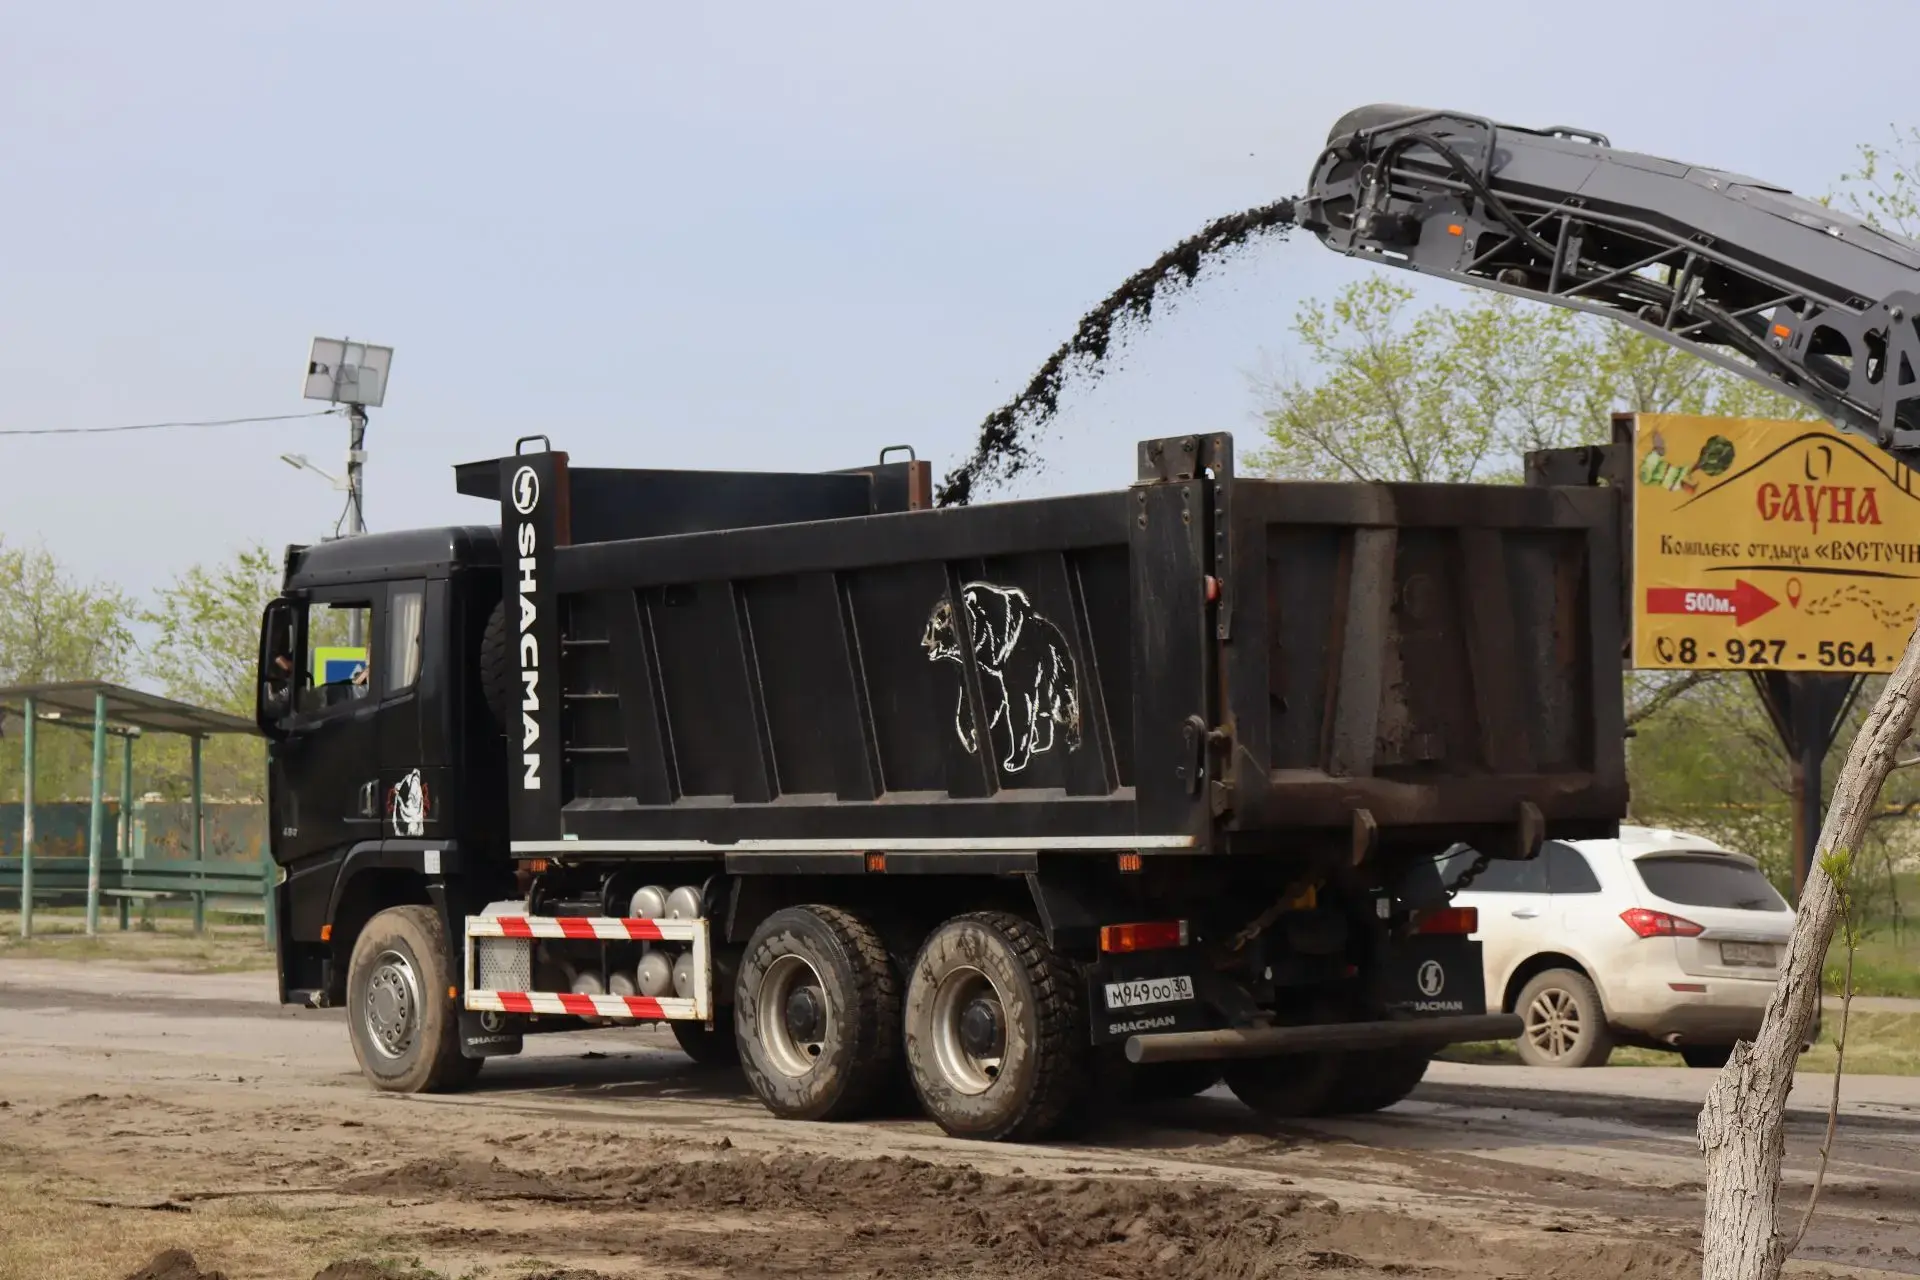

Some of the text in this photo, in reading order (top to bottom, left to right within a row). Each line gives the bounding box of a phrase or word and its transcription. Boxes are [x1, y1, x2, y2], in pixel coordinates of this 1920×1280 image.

[1747, 542, 1809, 564] отдыха
[518, 522, 541, 789] SHACMAN
[1725, 638, 1787, 665] 927
[1818, 641, 1876, 667] 564
[1109, 1015, 1176, 1034] SHACMAN
